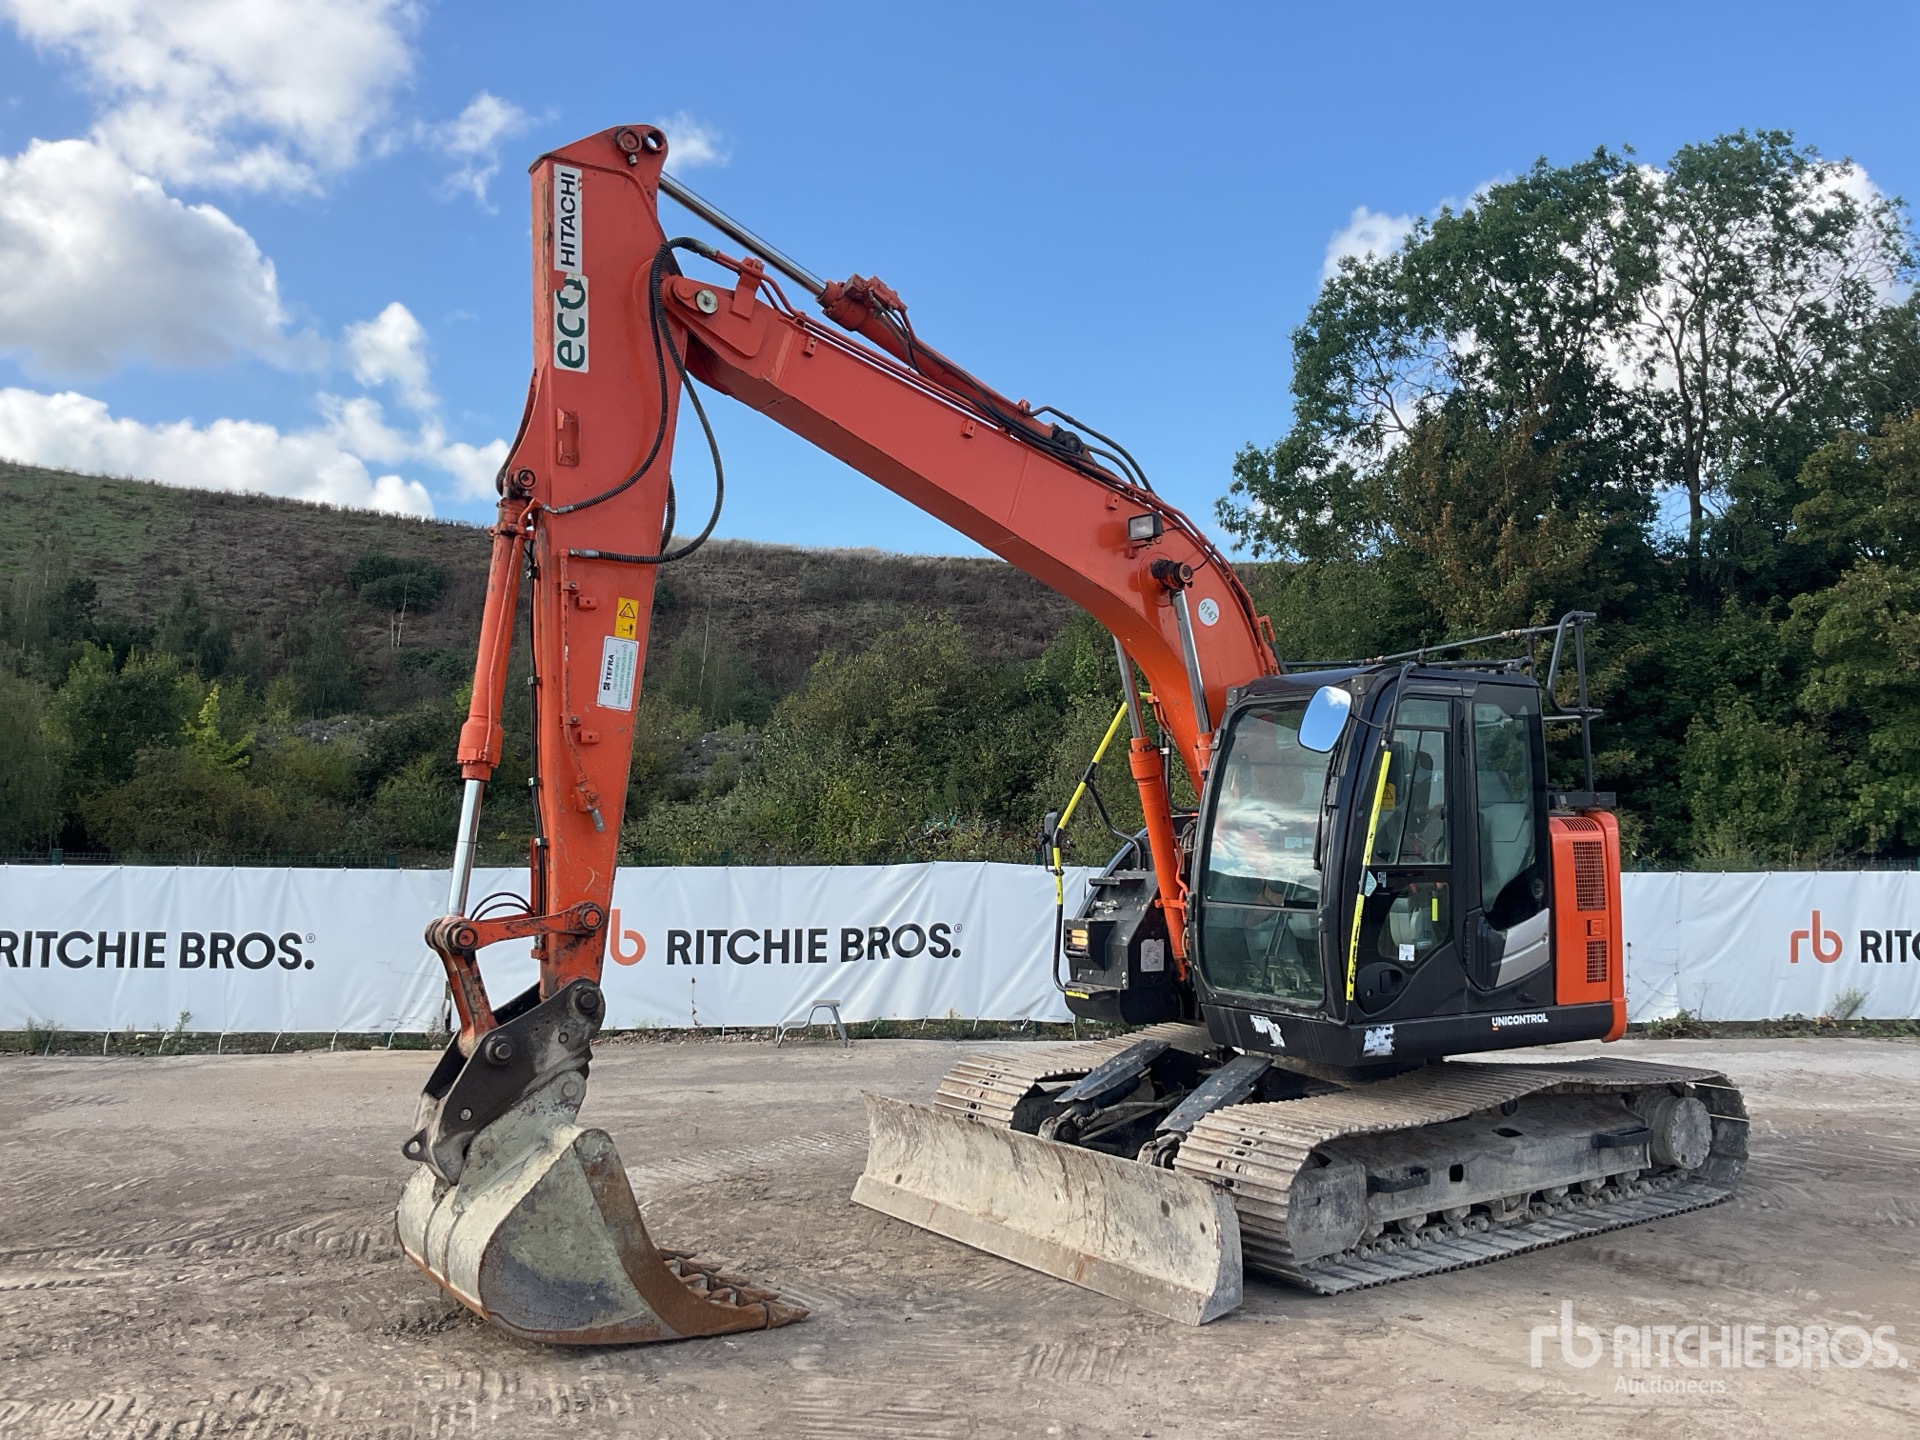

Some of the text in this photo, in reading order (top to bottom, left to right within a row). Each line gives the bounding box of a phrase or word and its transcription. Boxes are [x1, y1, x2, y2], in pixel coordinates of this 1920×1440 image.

[560, 172, 576, 267] HITACHI
[1201, 602, 1218, 622] 0147
[606, 654, 615, 681] TEFRA
[0, 930, 166, 969] RITCHIE
[666, 927, 828, 966] RITCHIE
[1790, 910, 1843, 964] rb
[1491, 1013, 1549, 1027] UNICONTROL
